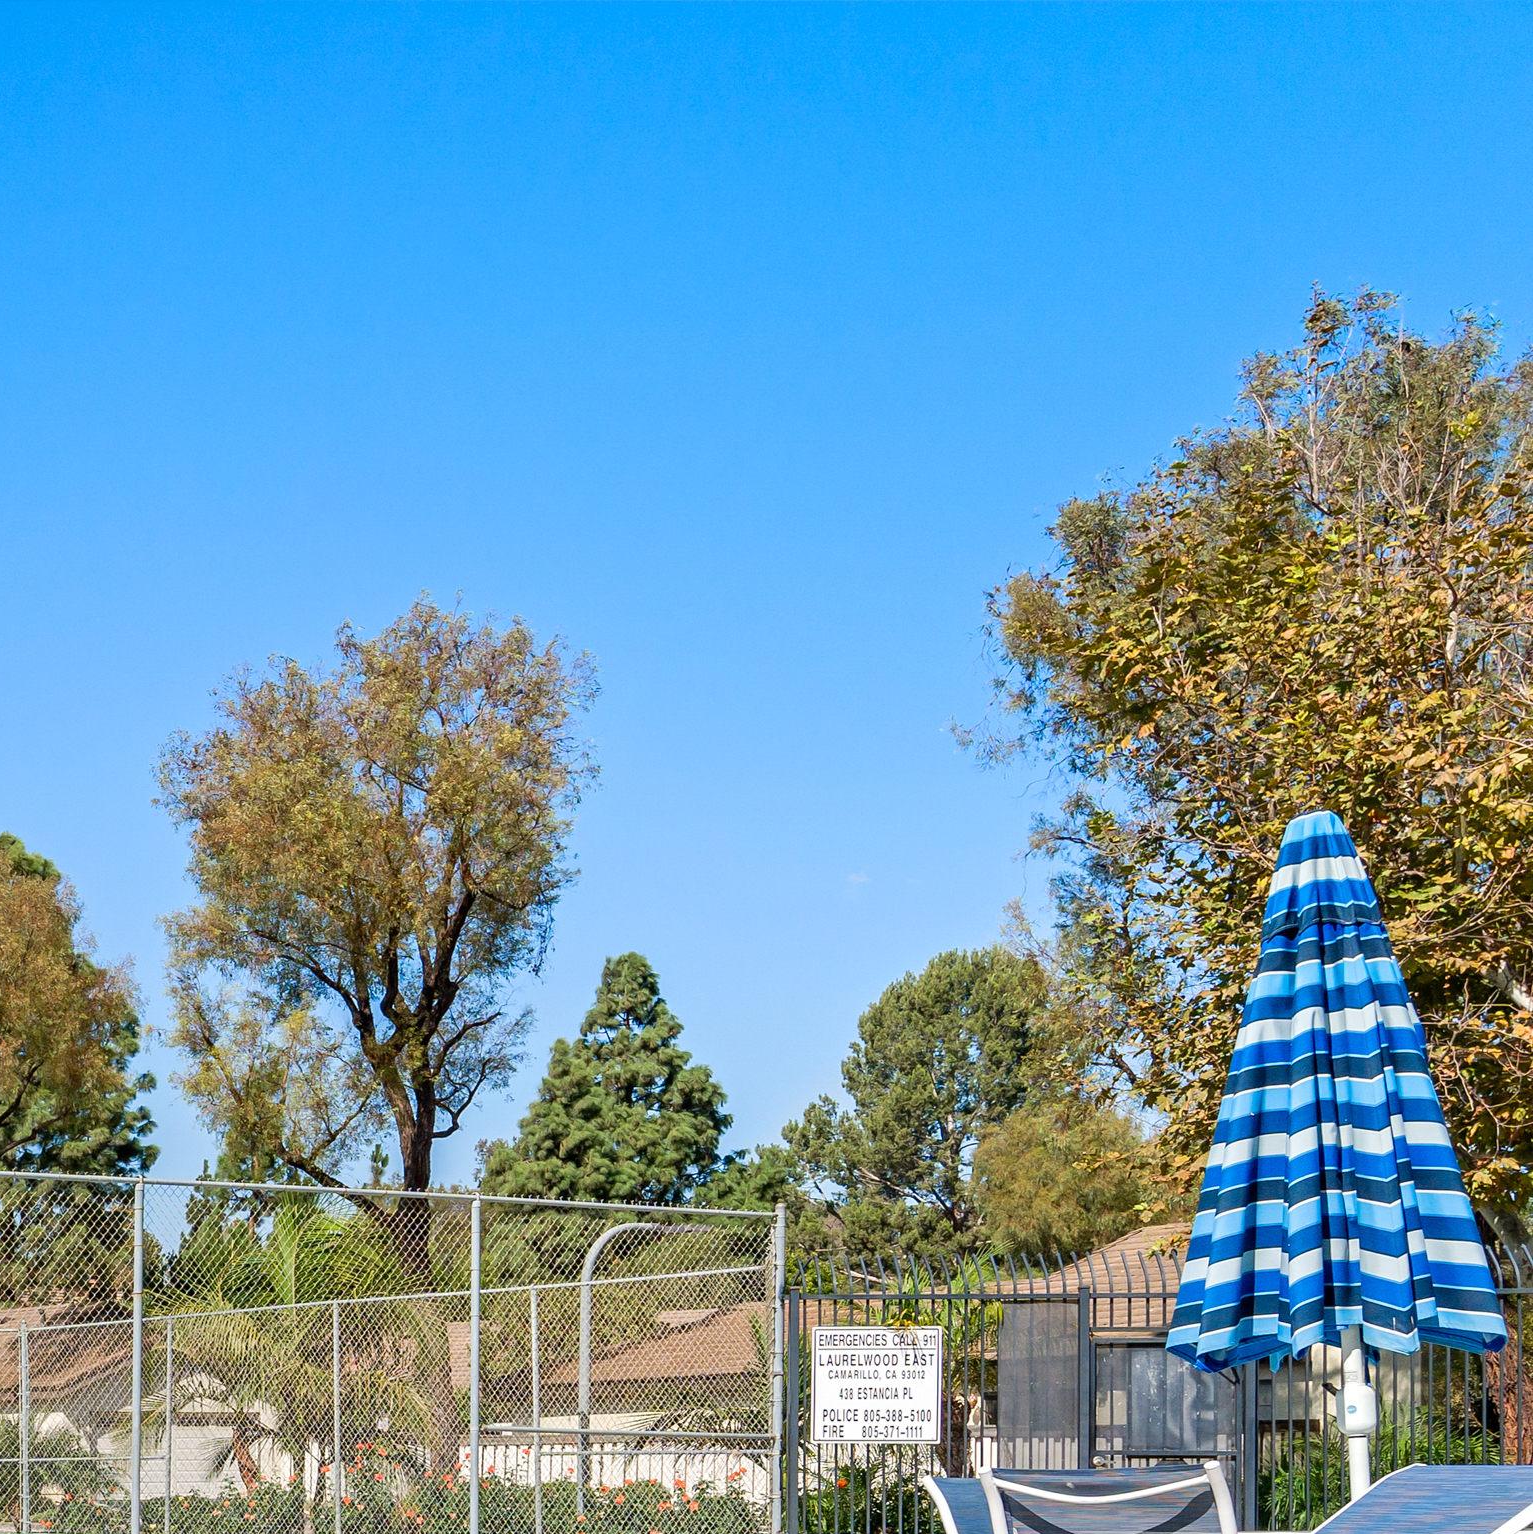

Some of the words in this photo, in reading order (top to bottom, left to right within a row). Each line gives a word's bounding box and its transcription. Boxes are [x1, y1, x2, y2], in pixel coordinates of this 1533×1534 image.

[818, 1334, 888, 1347] EMERGENCIES
[892, 1334, 918, 1347] CALL
[923, 1334, 937, 1347] 911
[819, 1354, 899, 1367] LAURELWOOD
[904, 1354, 935, 1367] EAST
[828, 1370, 882, 1381] CAMARILLO,
[885, 1370, 897, 1380] CA
[901, 1370, 926, 1380] 93012
[839, 1388, 854, 1400] 438
[857, 1388, 899, 1400] ESTANCIA
[902, 1388, 914, 1400] PL
[822, 1409, 859, 1422] POLICE
[863, 1409, 932, 1423] 805-388-5100
[822, 1425, 845, 1438] FIRE
[861, 1426, 923, 1439] 805-371-1111
